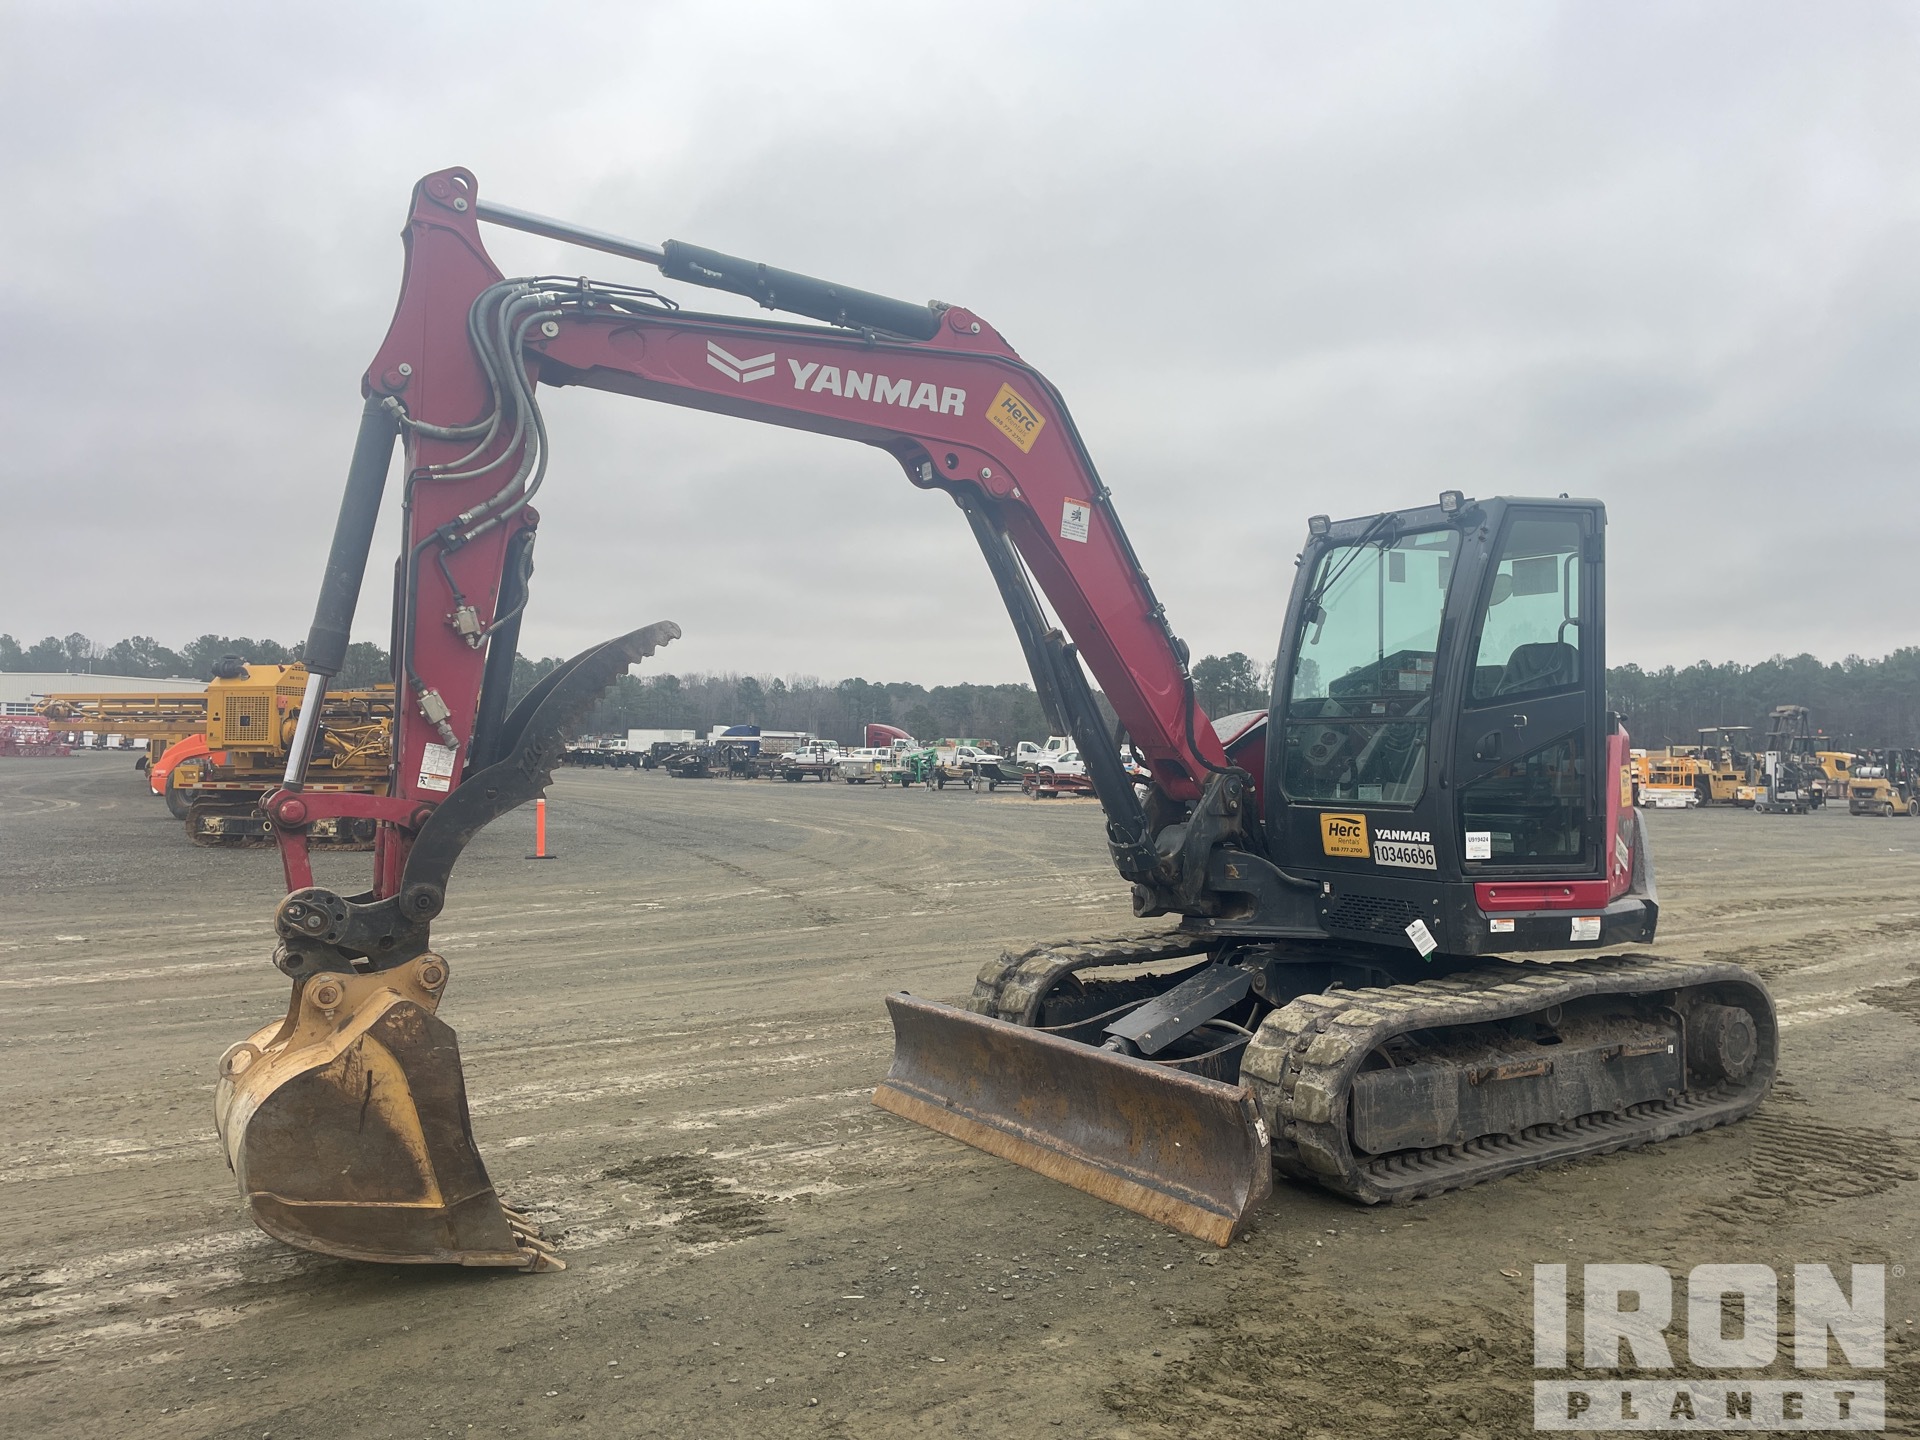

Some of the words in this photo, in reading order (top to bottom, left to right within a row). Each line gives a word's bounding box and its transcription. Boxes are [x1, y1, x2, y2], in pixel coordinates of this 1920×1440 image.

[787, 358, 967, 417] YANMAR
[1000, 397, 1035, 432] Herc
[1328, 822, 1361, 837] Herc
[1374, 828, 1431, 842] YANMAR
[1337, 837, 1360, 845] Rentals
[1374, 845, 1434, 865] 10346696
